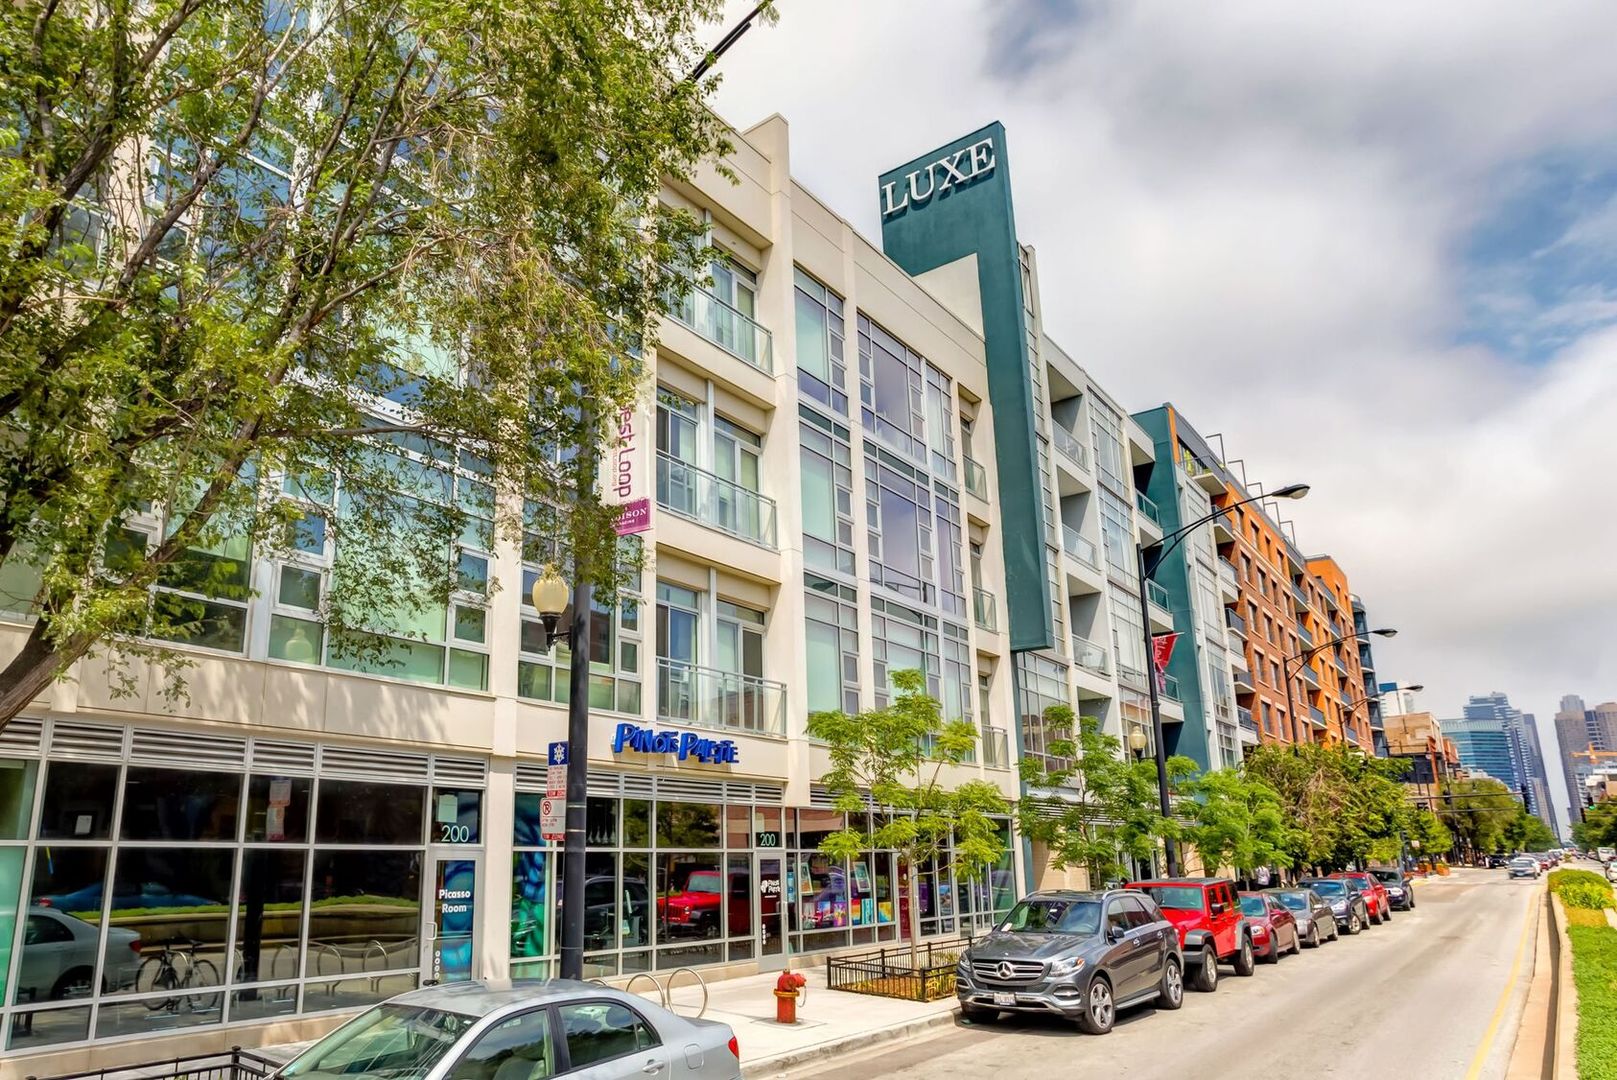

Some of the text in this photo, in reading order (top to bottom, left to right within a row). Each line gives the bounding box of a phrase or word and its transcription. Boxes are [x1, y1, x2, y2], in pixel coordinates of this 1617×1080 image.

[881, 137, 996, 215] LUXE
[613, 447, 636, 498] Loop
[441, 825, 470, 843] 200
[760, 833, 776, 847] 200
[438, 889, 471, 900] Picasso
[441, 903, 467, 913] Room
